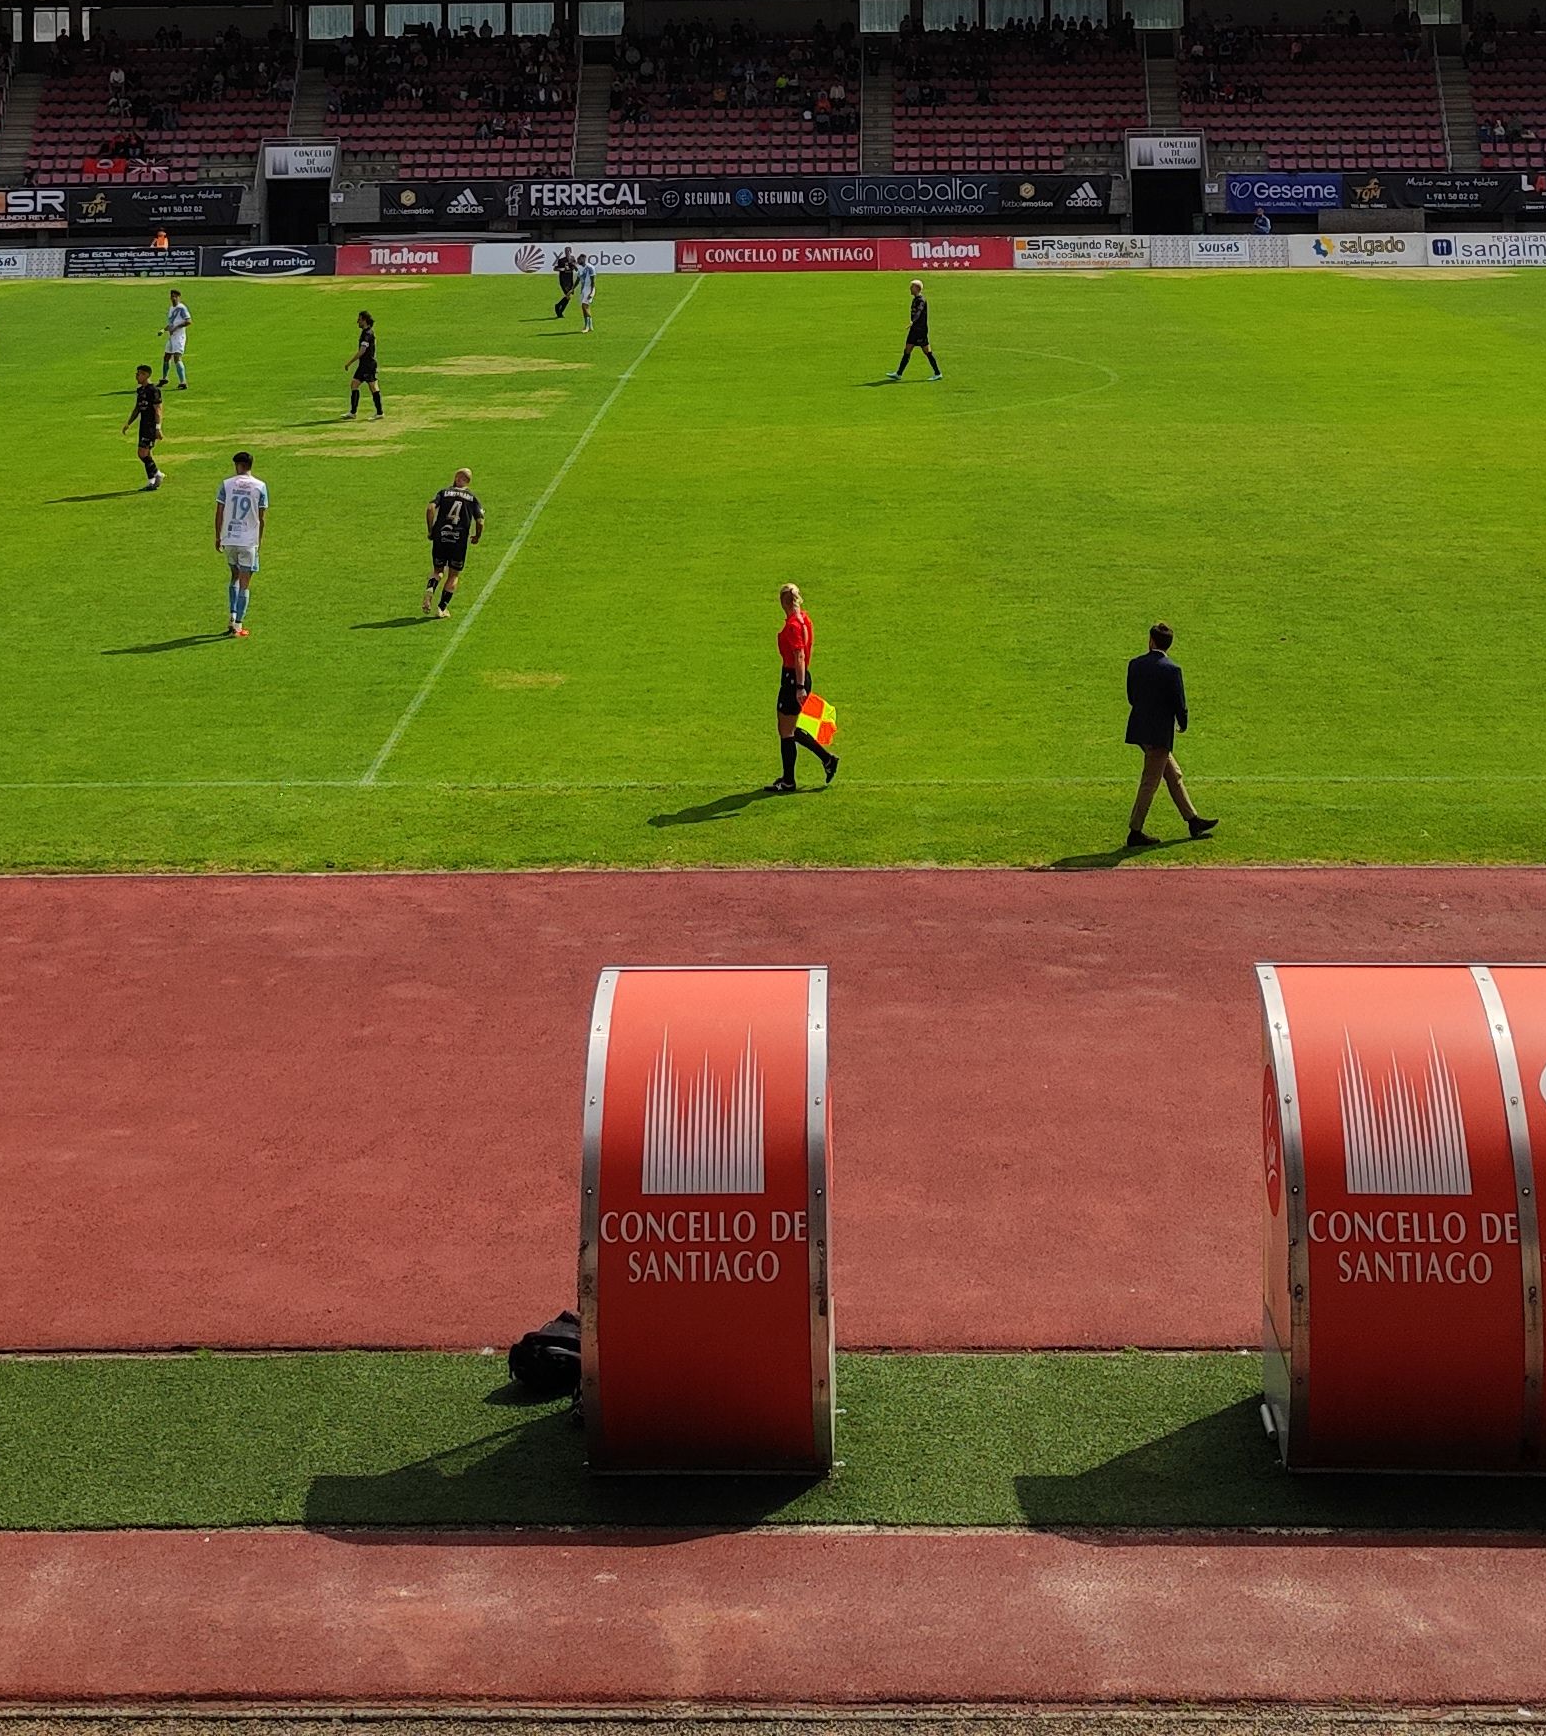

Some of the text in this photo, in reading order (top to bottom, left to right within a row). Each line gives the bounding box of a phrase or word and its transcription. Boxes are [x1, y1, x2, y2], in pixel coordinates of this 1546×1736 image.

[1159, 141, 1197, 149] CONCELLO
[294, 150, 332, 158] CONCELLO
[1253, 182, 1338, 199] Geseme
[1454, 180, 1470, 190] que
[7, 191, 65, 213] SR
[530, 183, 646, 206] FERRECAL
[684, 192, 731, 205] SEGUNDA
[758, 191, 804, 204] SEGUNDA
[1066, 197, 1102, 207] adidas
[447, 204, 484, 214] adidas
[542, 206, 648, 216] Servicio del Profesional
[850, 205, 985, 214] INSTITUTO DENTAL AVANZADO
[910, 242, 981, 259] Mahou
[1027, 239, 1102, 252] SR Segundo
[1340, 236, 1406, 256] salgado
[370, 248, 439, 264] Mahou
[705, 246, 874, 263] CONCELLO DE SANTIAGO
[1021, 251, 1049, 260] BAÑOS
[1056, 251, 1092, 259] COCINAS
[221, 257, 316, 269] integral motion
[231, 495, 252, 520] 19
[447, 500, 463, 525] 4
[600, 1210, 808, 1243] CONCELLO DE
[1308, 1211, 1519, 1244] CONCELLO DE
[628, 1250, 780, 1283] SANTIAGO
[1338, 1251, 1493, 1284] SANTIAGO
